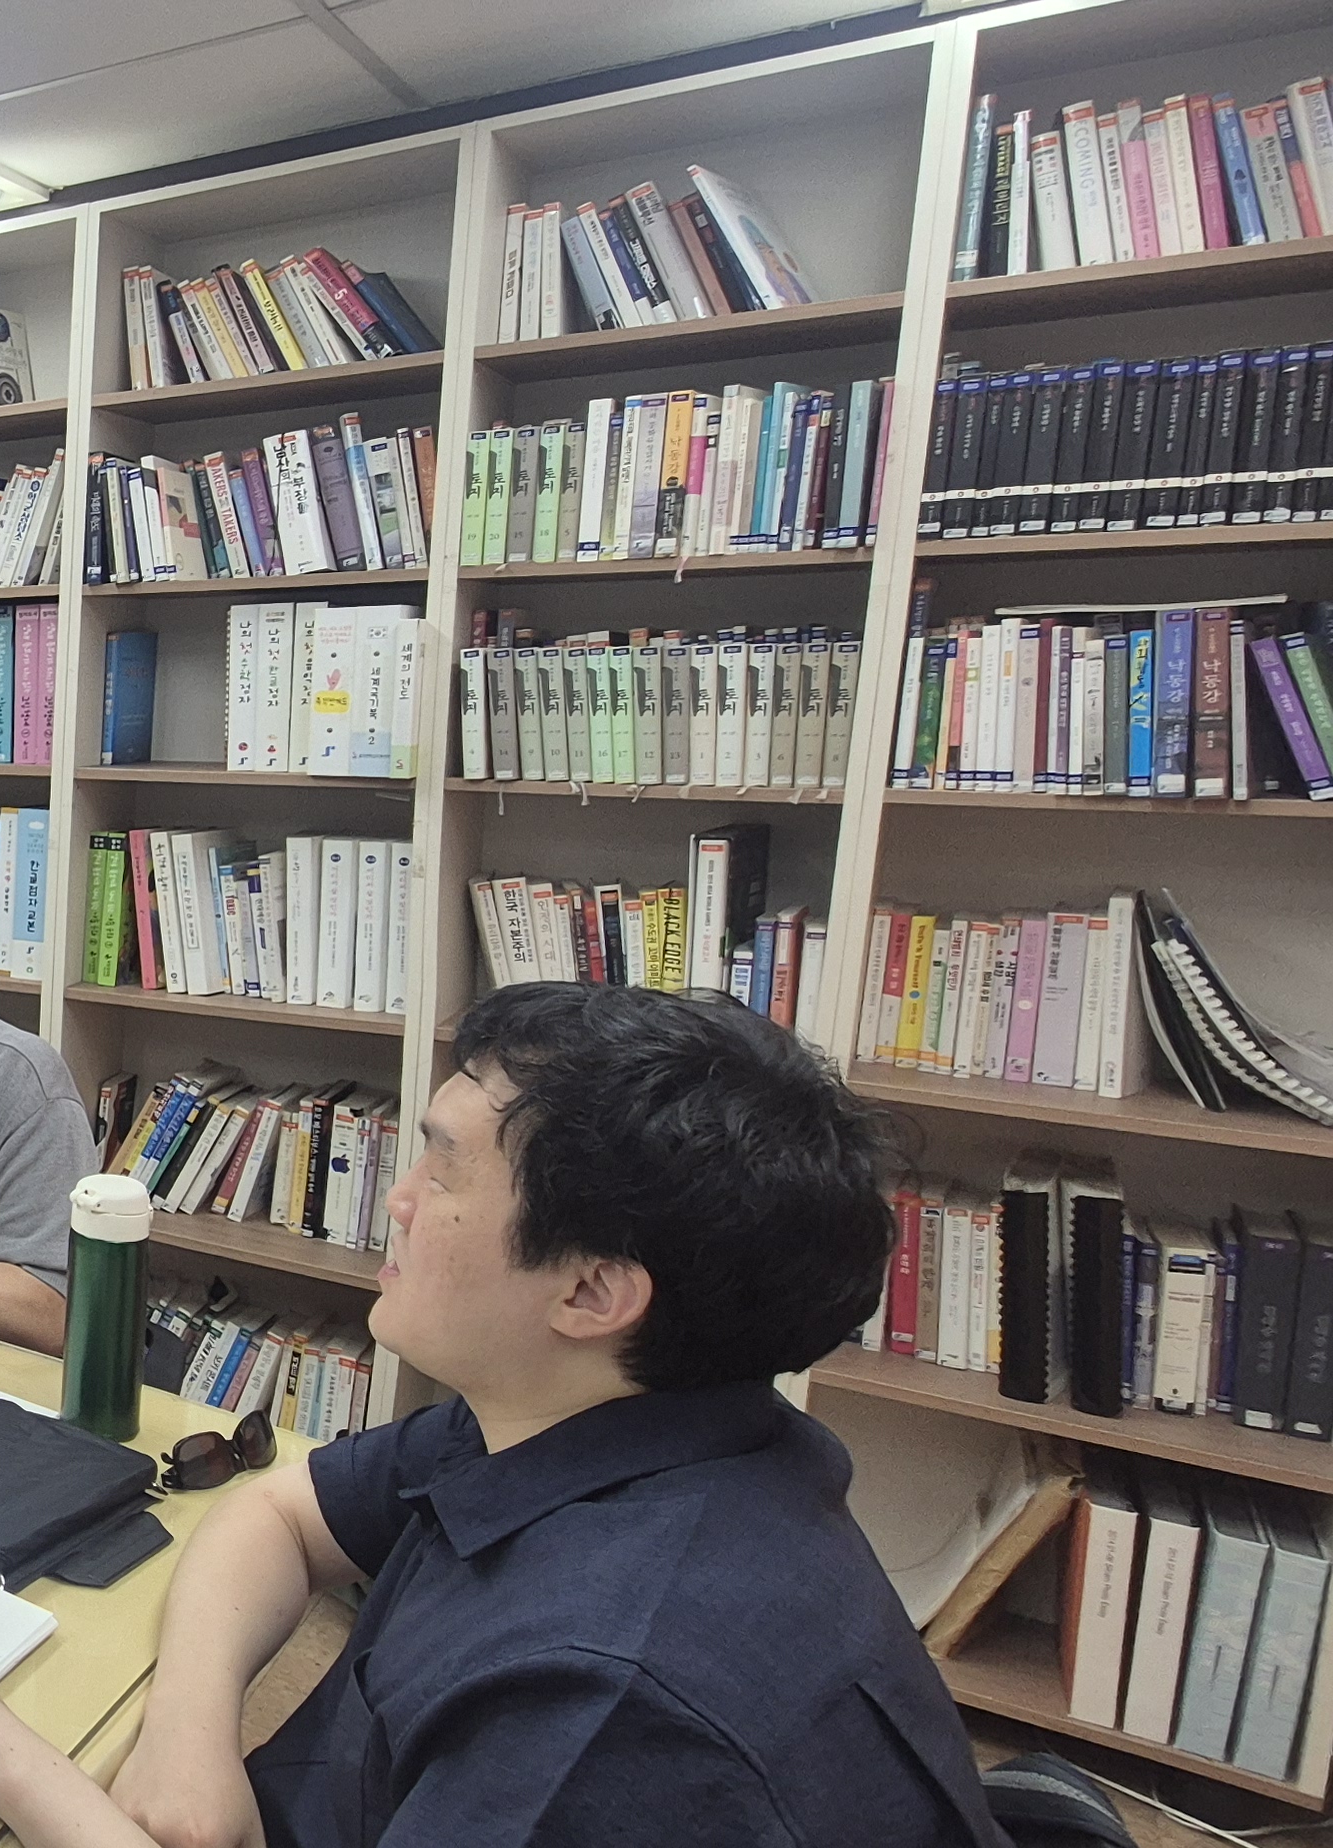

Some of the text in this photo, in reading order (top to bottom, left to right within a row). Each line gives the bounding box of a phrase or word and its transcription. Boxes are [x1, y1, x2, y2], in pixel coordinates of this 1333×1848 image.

[1073, 119, 1090, 190] ECOMING
[471, 473, 483, 499] 토지
[493, 473, 505, 499] 토지
[518, 470, 531, 497] 토지
[544, 468, 556, 495] 토지
[567, 467, 580, 494] 토지
[221, 507, 239, 545] TAKERS
[268, 629, 281, 645] 나의
[239, 621, 252, 704] 나의 첫 수학점자
[268, 649, 280, 660] 첫
[401, 643, 413, 672] 세계의
[267, 665, 279, 707] 한글점자
[1167, 660, 1187, 704] 낙동강
[1202, 660, 1222, 704] 낙동강
[467, 689, 479, 716] 토지
[497, 689, 510, 716] 토지
[524, 689, 537, 716] 토지
[548, 689, 561, 716] 토지
[572, 689, 586, 717] 토지
[596, 689, 609, 716] 토지
[617, 689, 630, 717] 토지
[644, 689, 658, 717] 토지
[671, 689, 685, 717] 토지
[698, 689, 712, 717] 토지
[725, 688, 739, 716] 토지
[756, 688, 770, 717] 토지
[782, 688, 795, 718] 토지
[810, 688, 824, 718] 토지
[838, 688, 852, 718] 토지
[368, 736, 375, 745] 2
[27, 860, 40, 933] 한글점자교본
[503, 889, 526, 963] 한국 자본주의
[665, 898, 682, 974] BLACK EDGE
